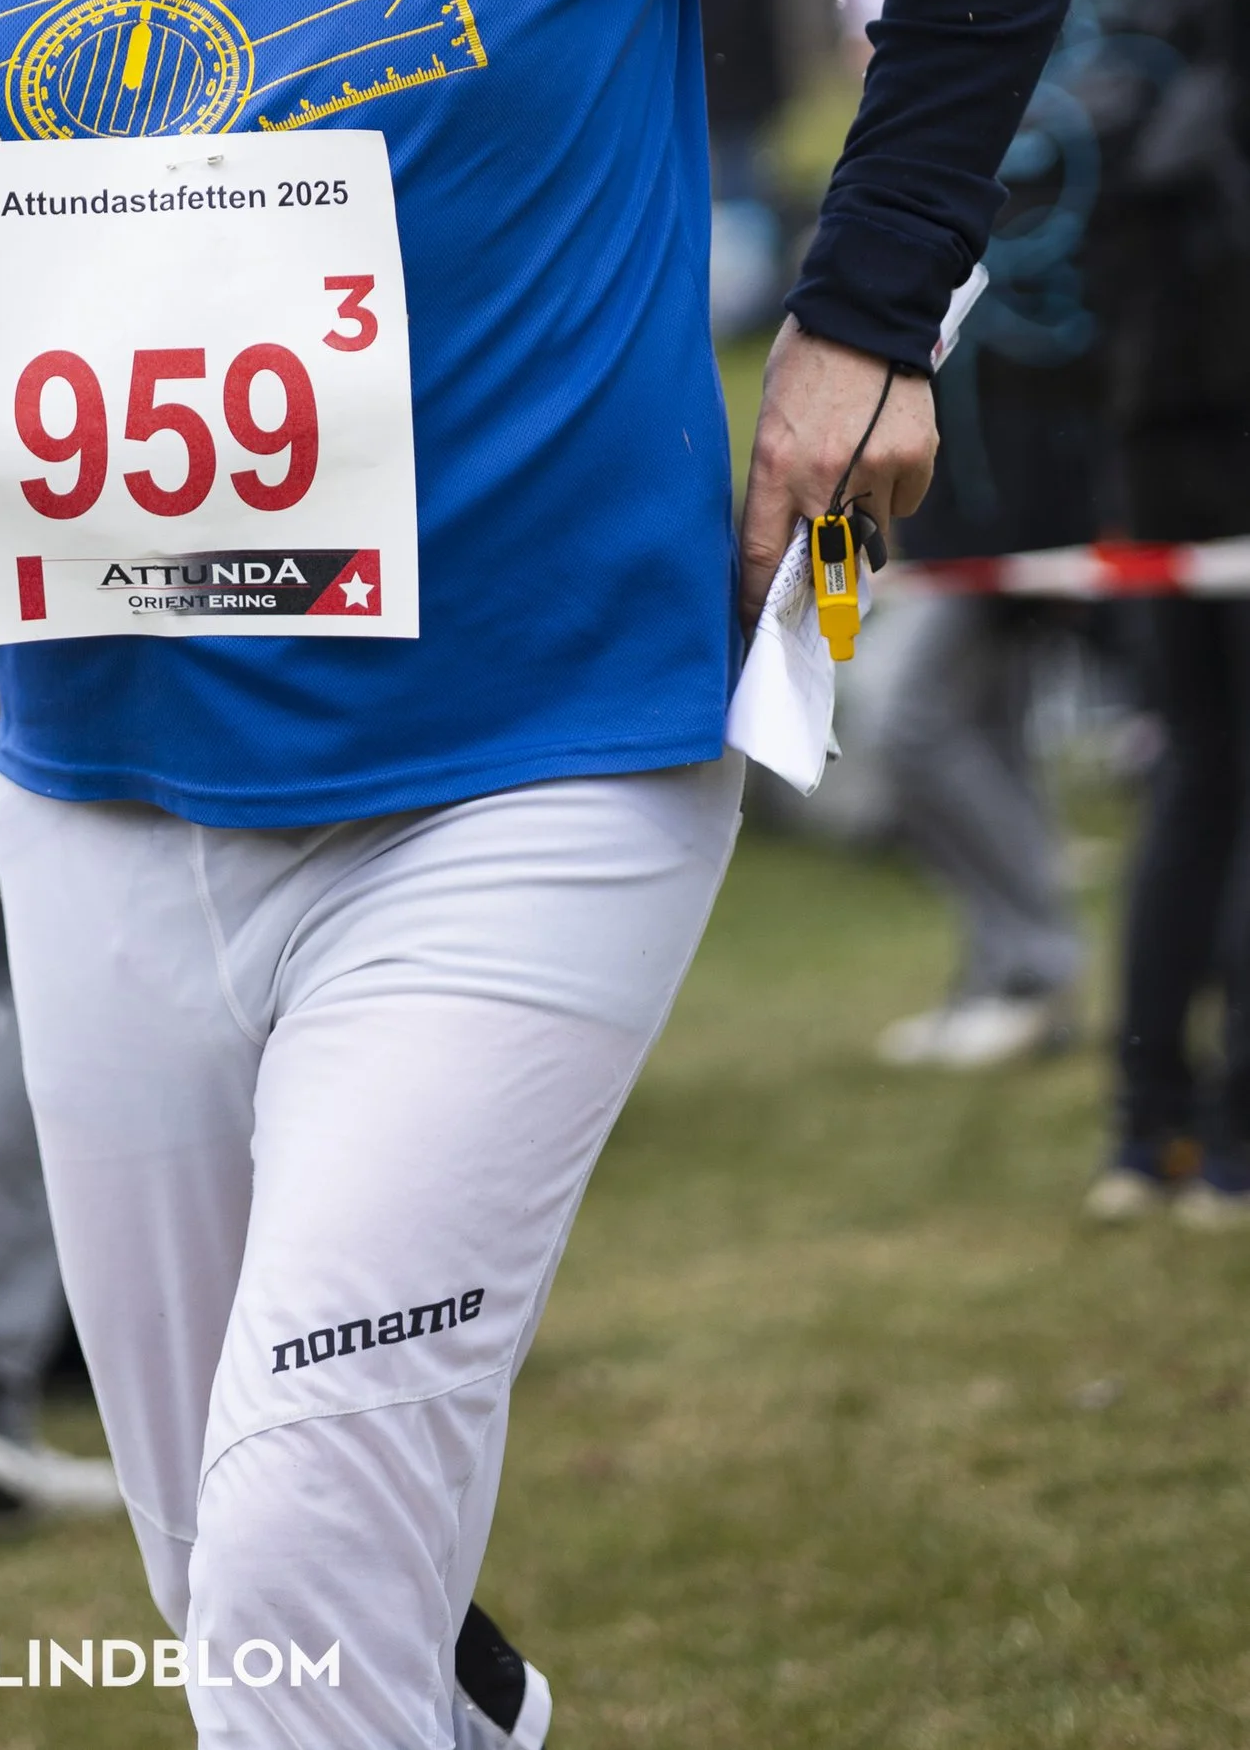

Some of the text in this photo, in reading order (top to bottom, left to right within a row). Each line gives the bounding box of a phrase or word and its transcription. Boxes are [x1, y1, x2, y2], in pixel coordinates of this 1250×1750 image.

[0, 180, 349, 217] Attundastafetten 2025
[322, 274, 379, 352] 3
[14, 342, 320, 520] 959
[101, 558, 309, 586] ATTUNDA
[127, 594, 277, 610] ORIENTERING
[271, 1287, 485, 1374] noname
